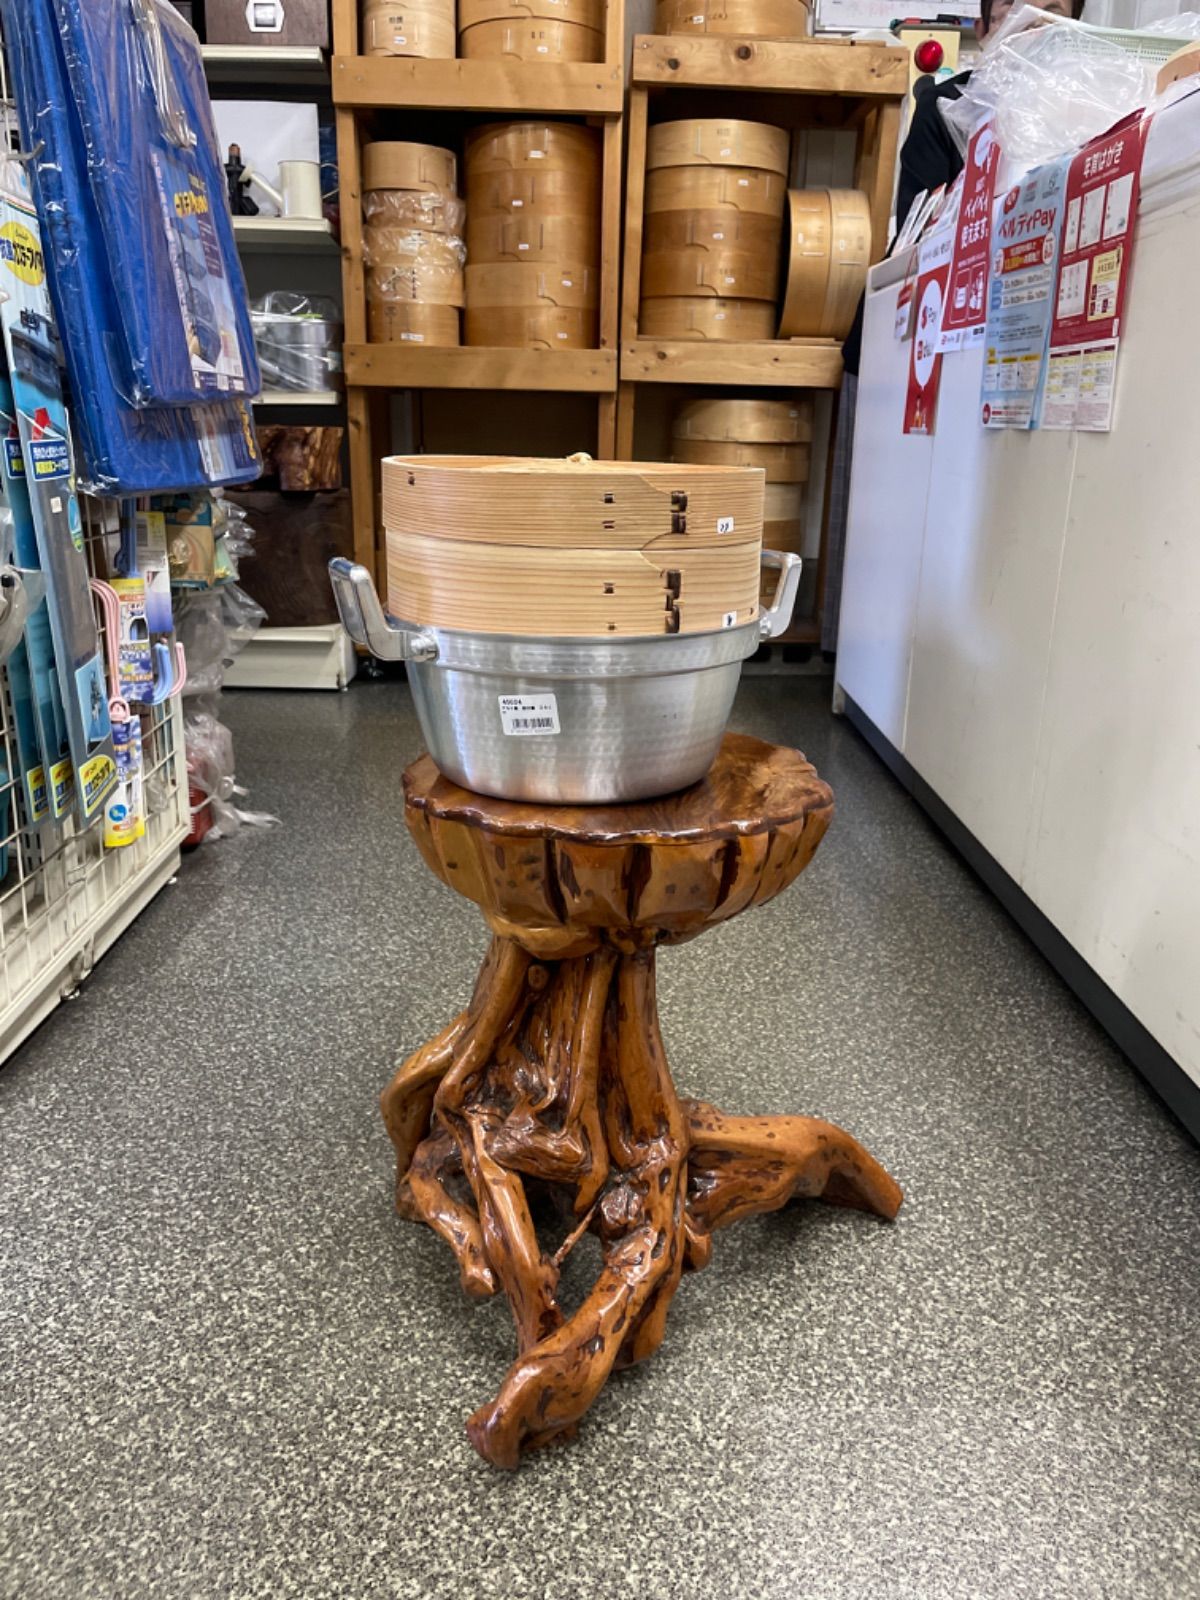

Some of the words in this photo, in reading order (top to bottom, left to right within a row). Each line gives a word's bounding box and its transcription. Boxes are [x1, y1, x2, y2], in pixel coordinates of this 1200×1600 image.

[1083, 140, 1124, 178] 年賀はがき
